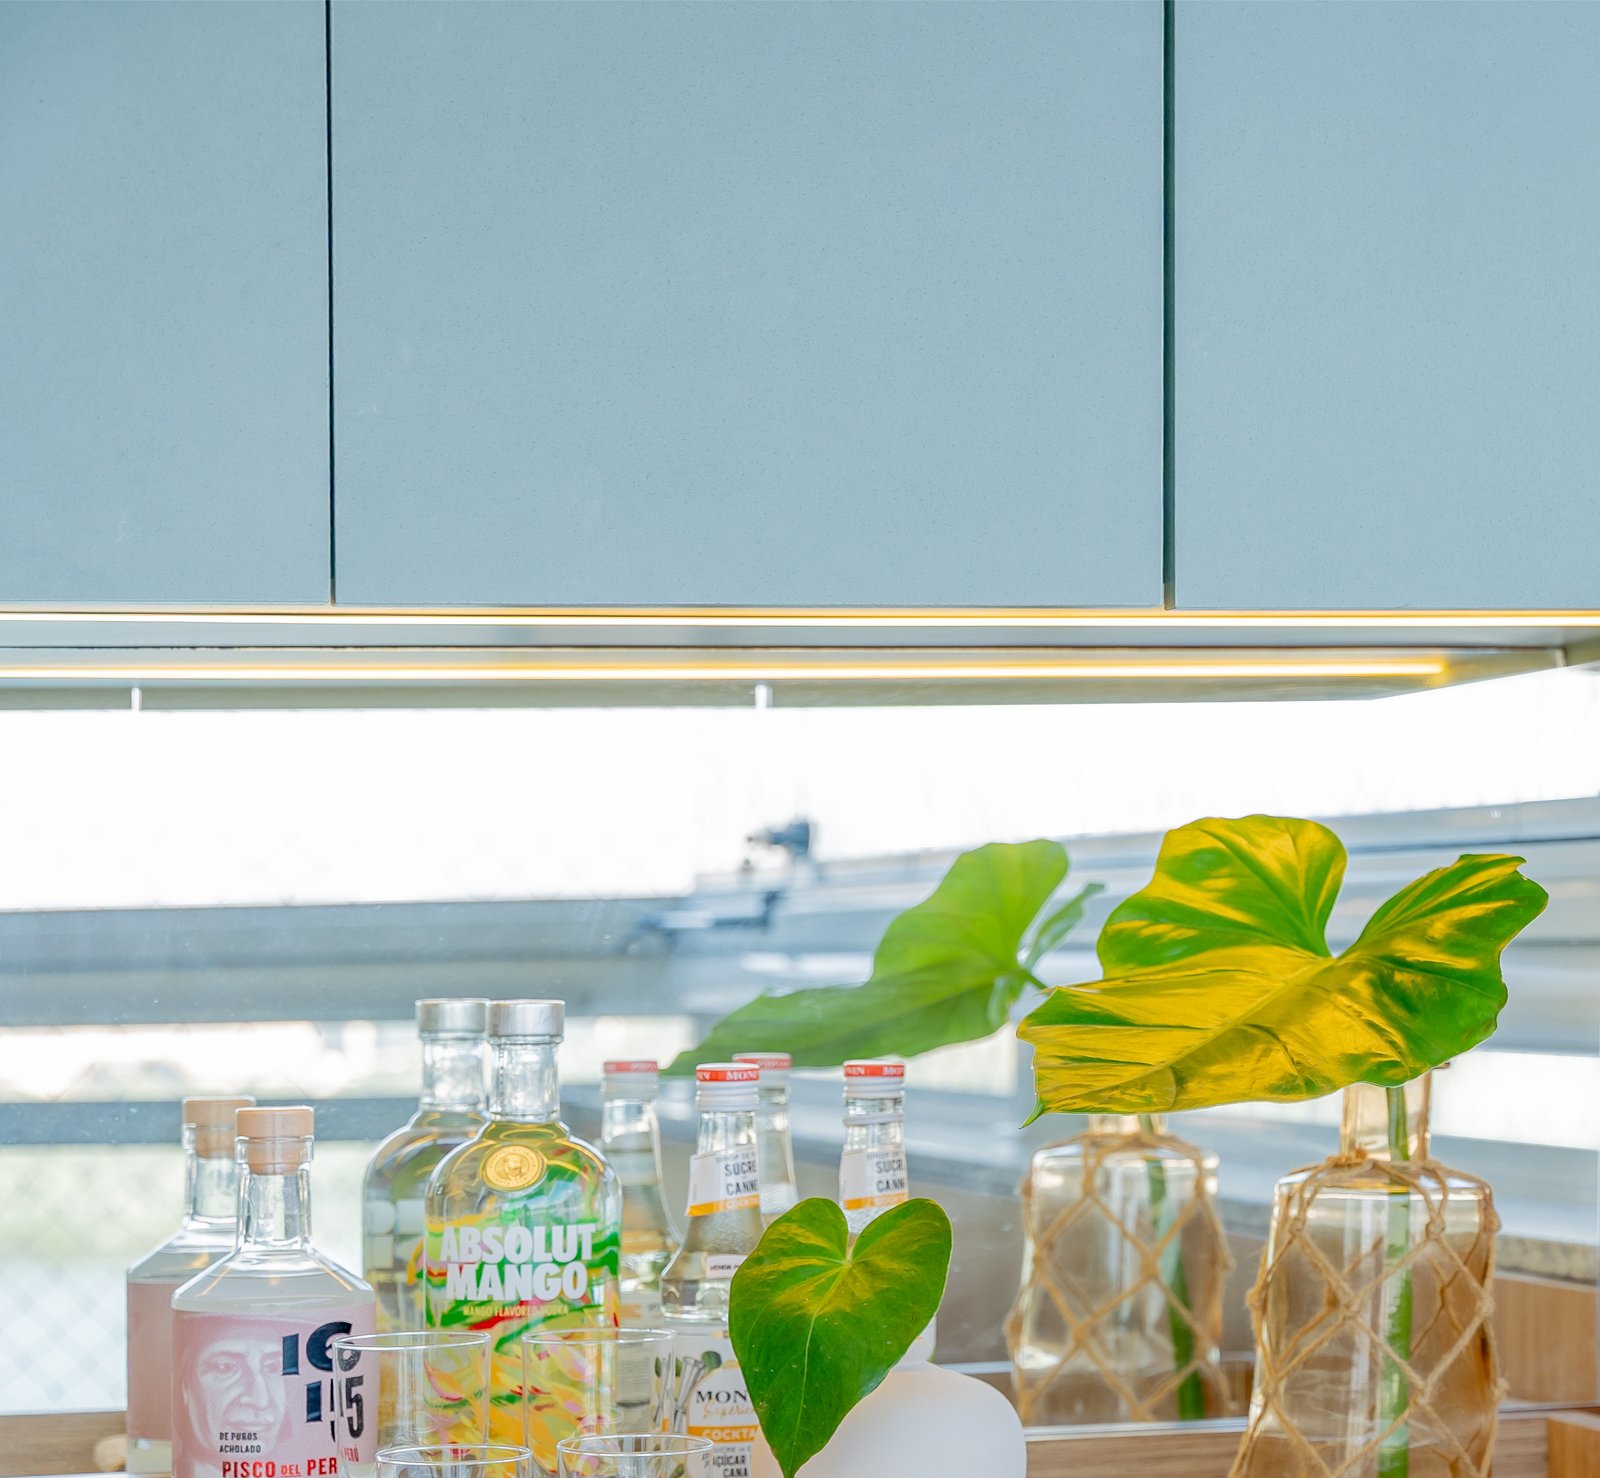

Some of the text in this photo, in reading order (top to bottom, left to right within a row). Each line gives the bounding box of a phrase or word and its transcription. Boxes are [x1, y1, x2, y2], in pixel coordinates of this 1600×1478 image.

[439, 1222, 596, 1265] ABSOLUT
[446, 1261, 588, 1301] MANGO
[219, 1432, 258, 1441] DE PUROS
[219, 1444, 261, 1454] ACHOLADO
[222, 1460, 276, 1478] PISCO
[280, 1464, 301, 1476] DEL
